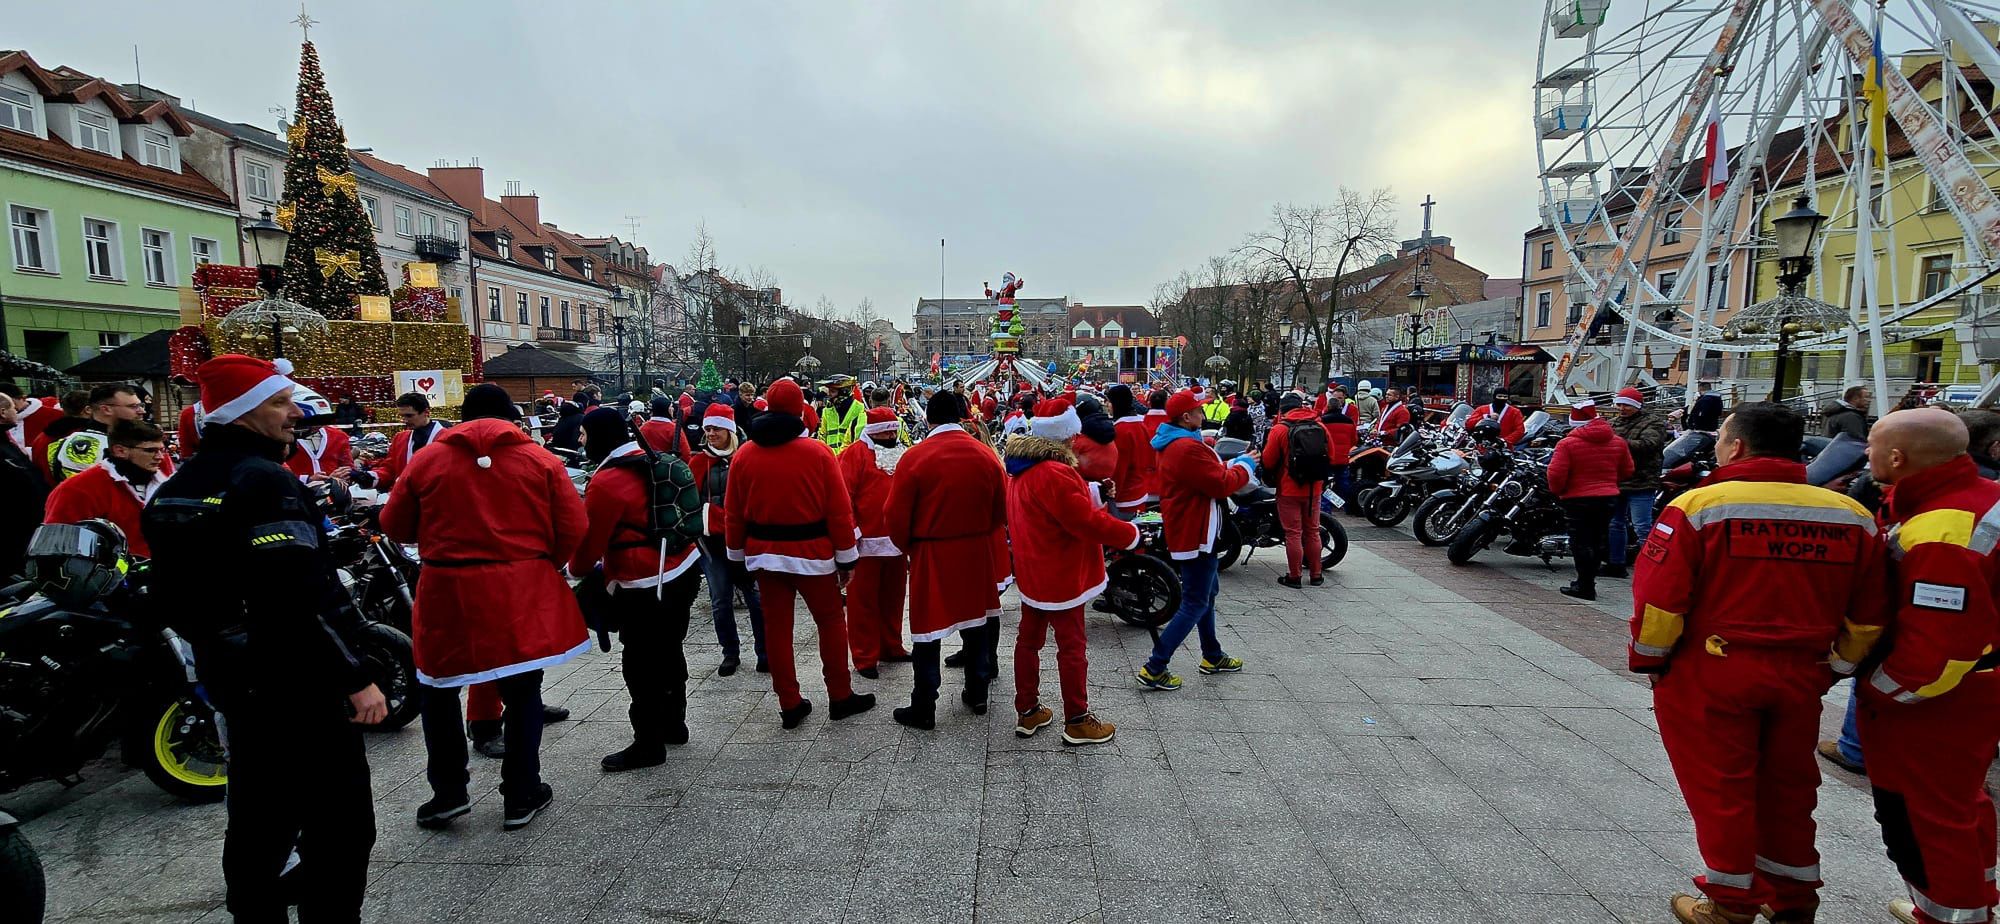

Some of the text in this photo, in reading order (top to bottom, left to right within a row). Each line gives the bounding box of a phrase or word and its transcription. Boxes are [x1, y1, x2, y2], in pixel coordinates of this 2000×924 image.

[409, 378, 418, 393] I
[1740, 521, 1852, 543] RATOWNIK
[1767, 541, 1829, 560] WOPR
